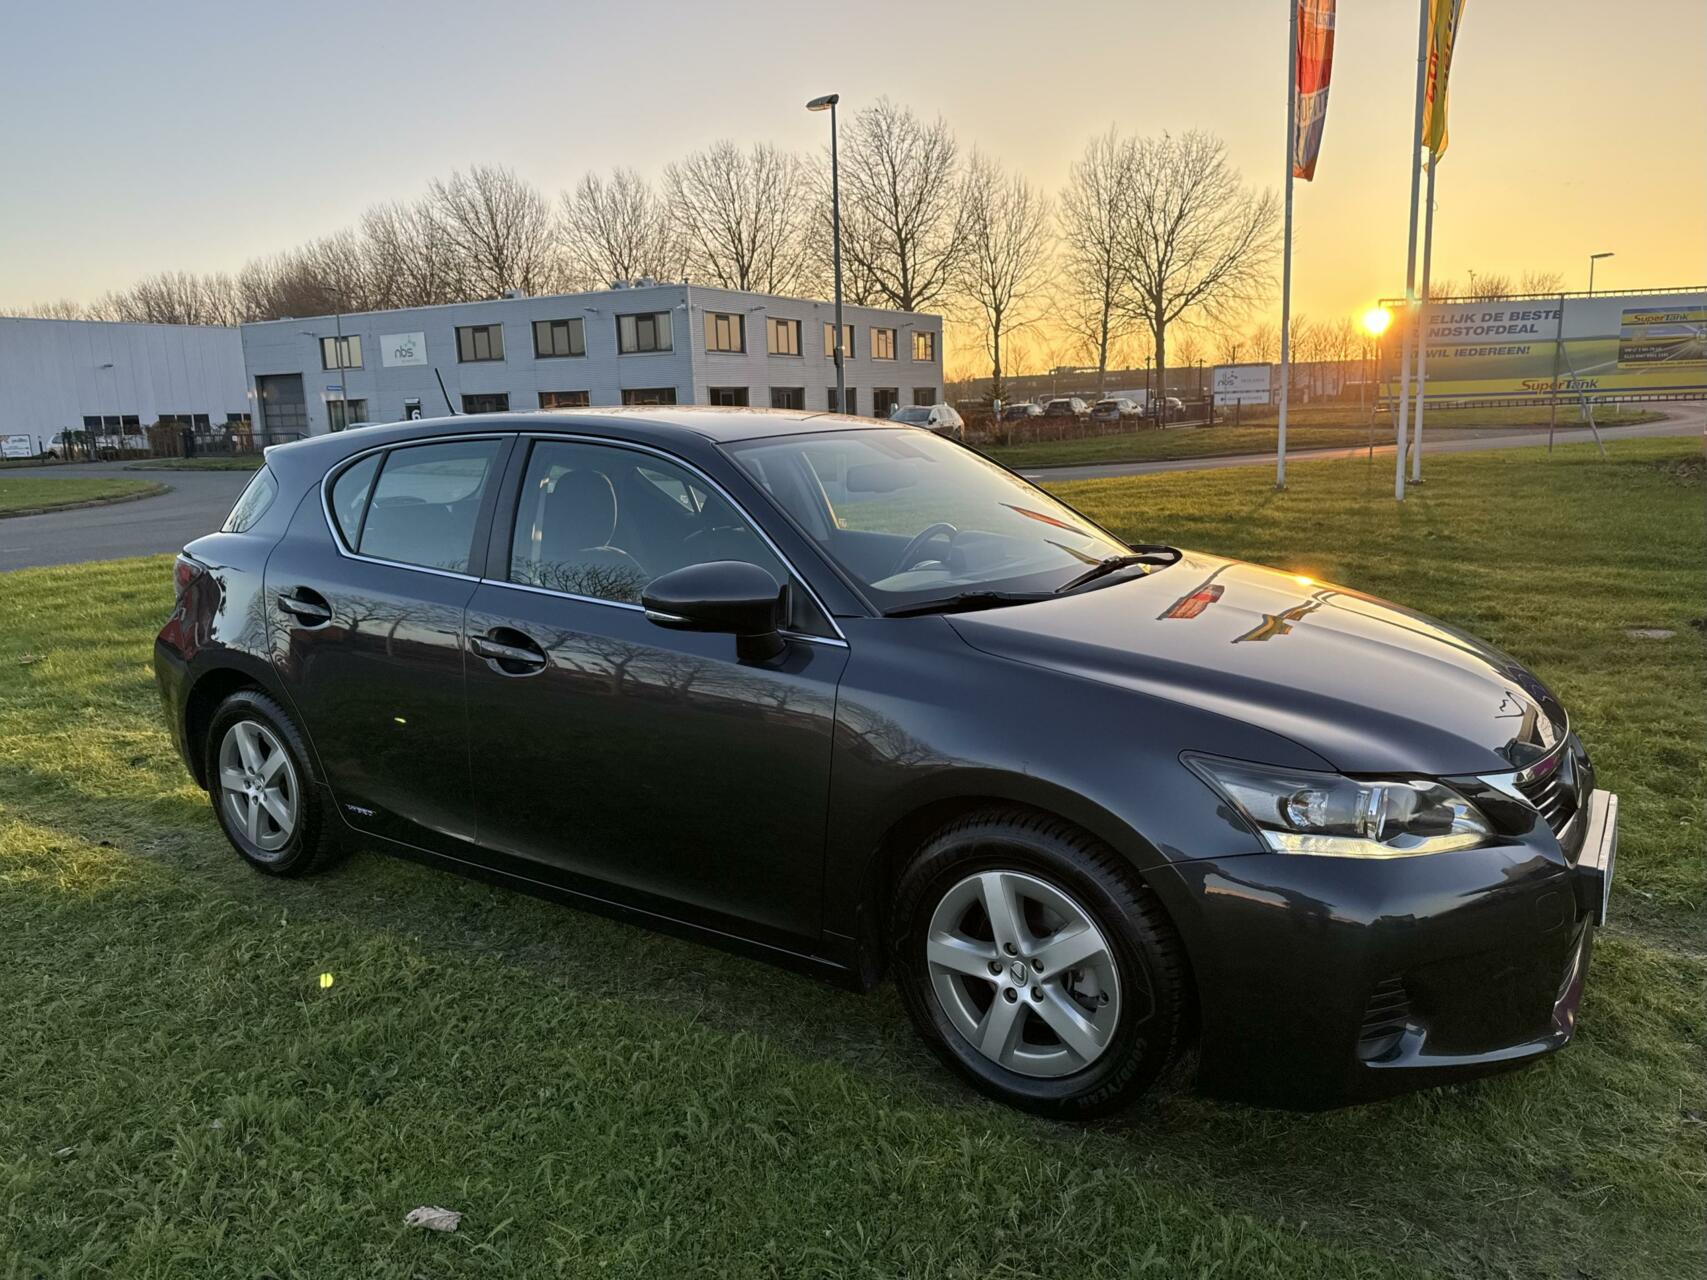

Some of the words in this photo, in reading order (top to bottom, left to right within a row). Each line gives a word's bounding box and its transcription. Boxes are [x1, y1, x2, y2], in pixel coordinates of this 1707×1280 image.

[1430, 313, 1477, 325] ELIJK
[1480, 312, 1504, 323] DE
[1508, 310, 1561, 322] BESTE
[1428, 323, 1539, 338] NDSTOFDEAL
[394, 345, 414, 358] nbs
[1425, 349, 1450, 359] WIL
[1454, 345, 1530, 358] IEDEREEN!
[411, 409, 421, 421] 6
